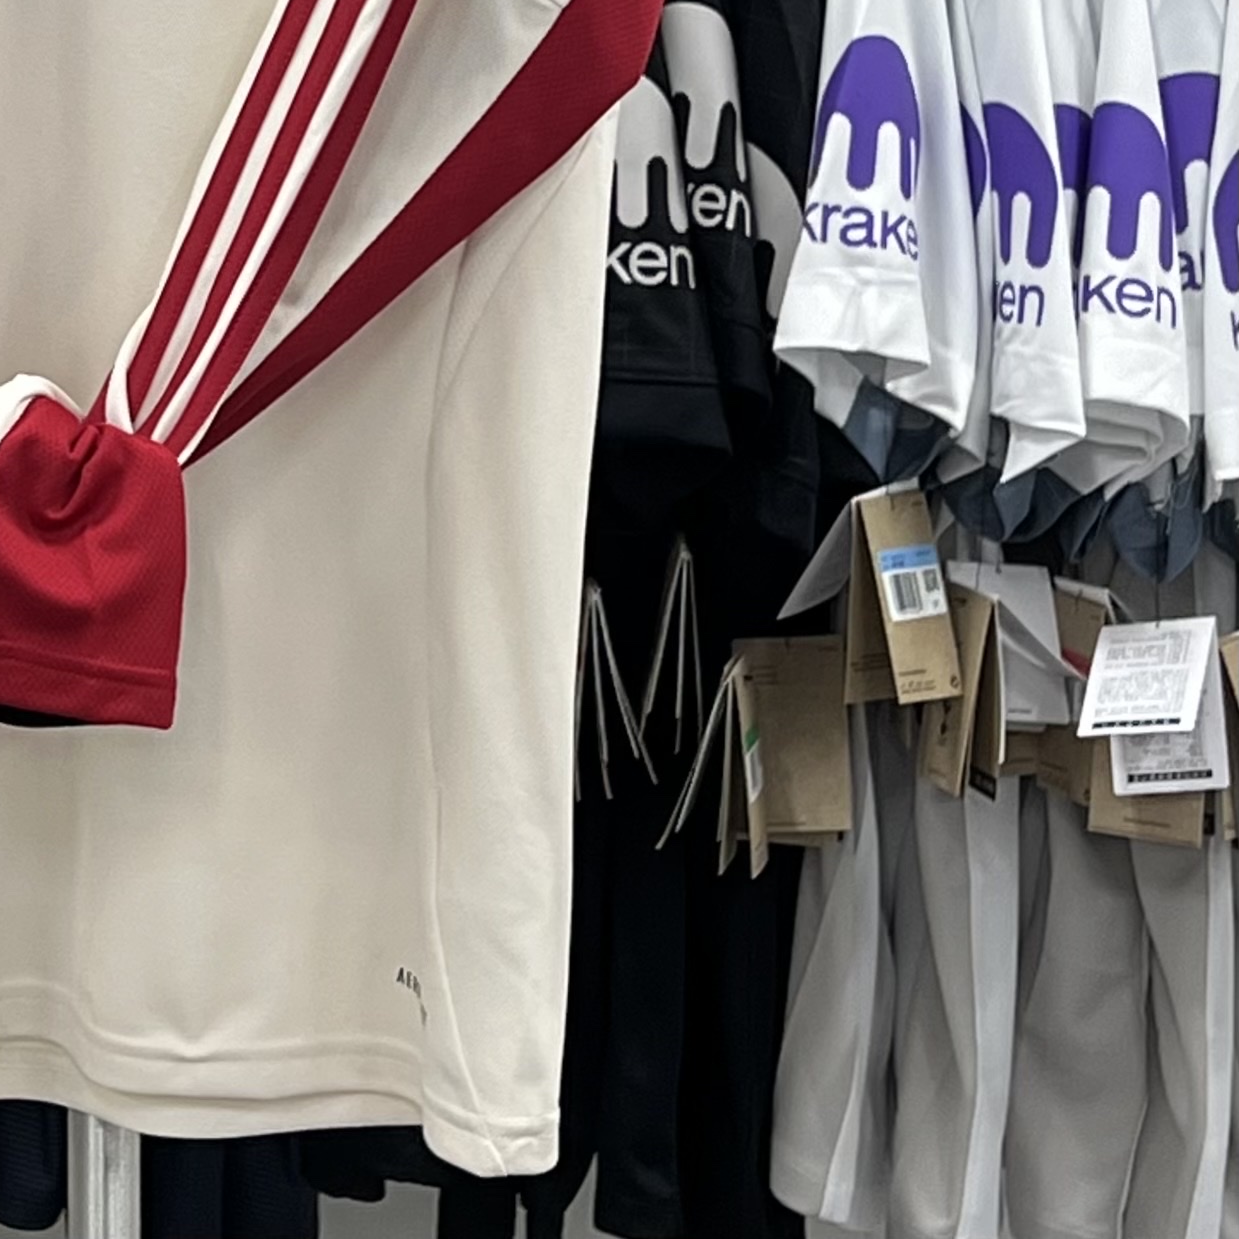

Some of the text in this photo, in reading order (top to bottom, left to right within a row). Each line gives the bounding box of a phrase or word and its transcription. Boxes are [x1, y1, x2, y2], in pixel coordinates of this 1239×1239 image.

[687, 183, 751, 238] en
[995, 280, 1045, 327] en
[1081, 274, 1177, 330] ken
